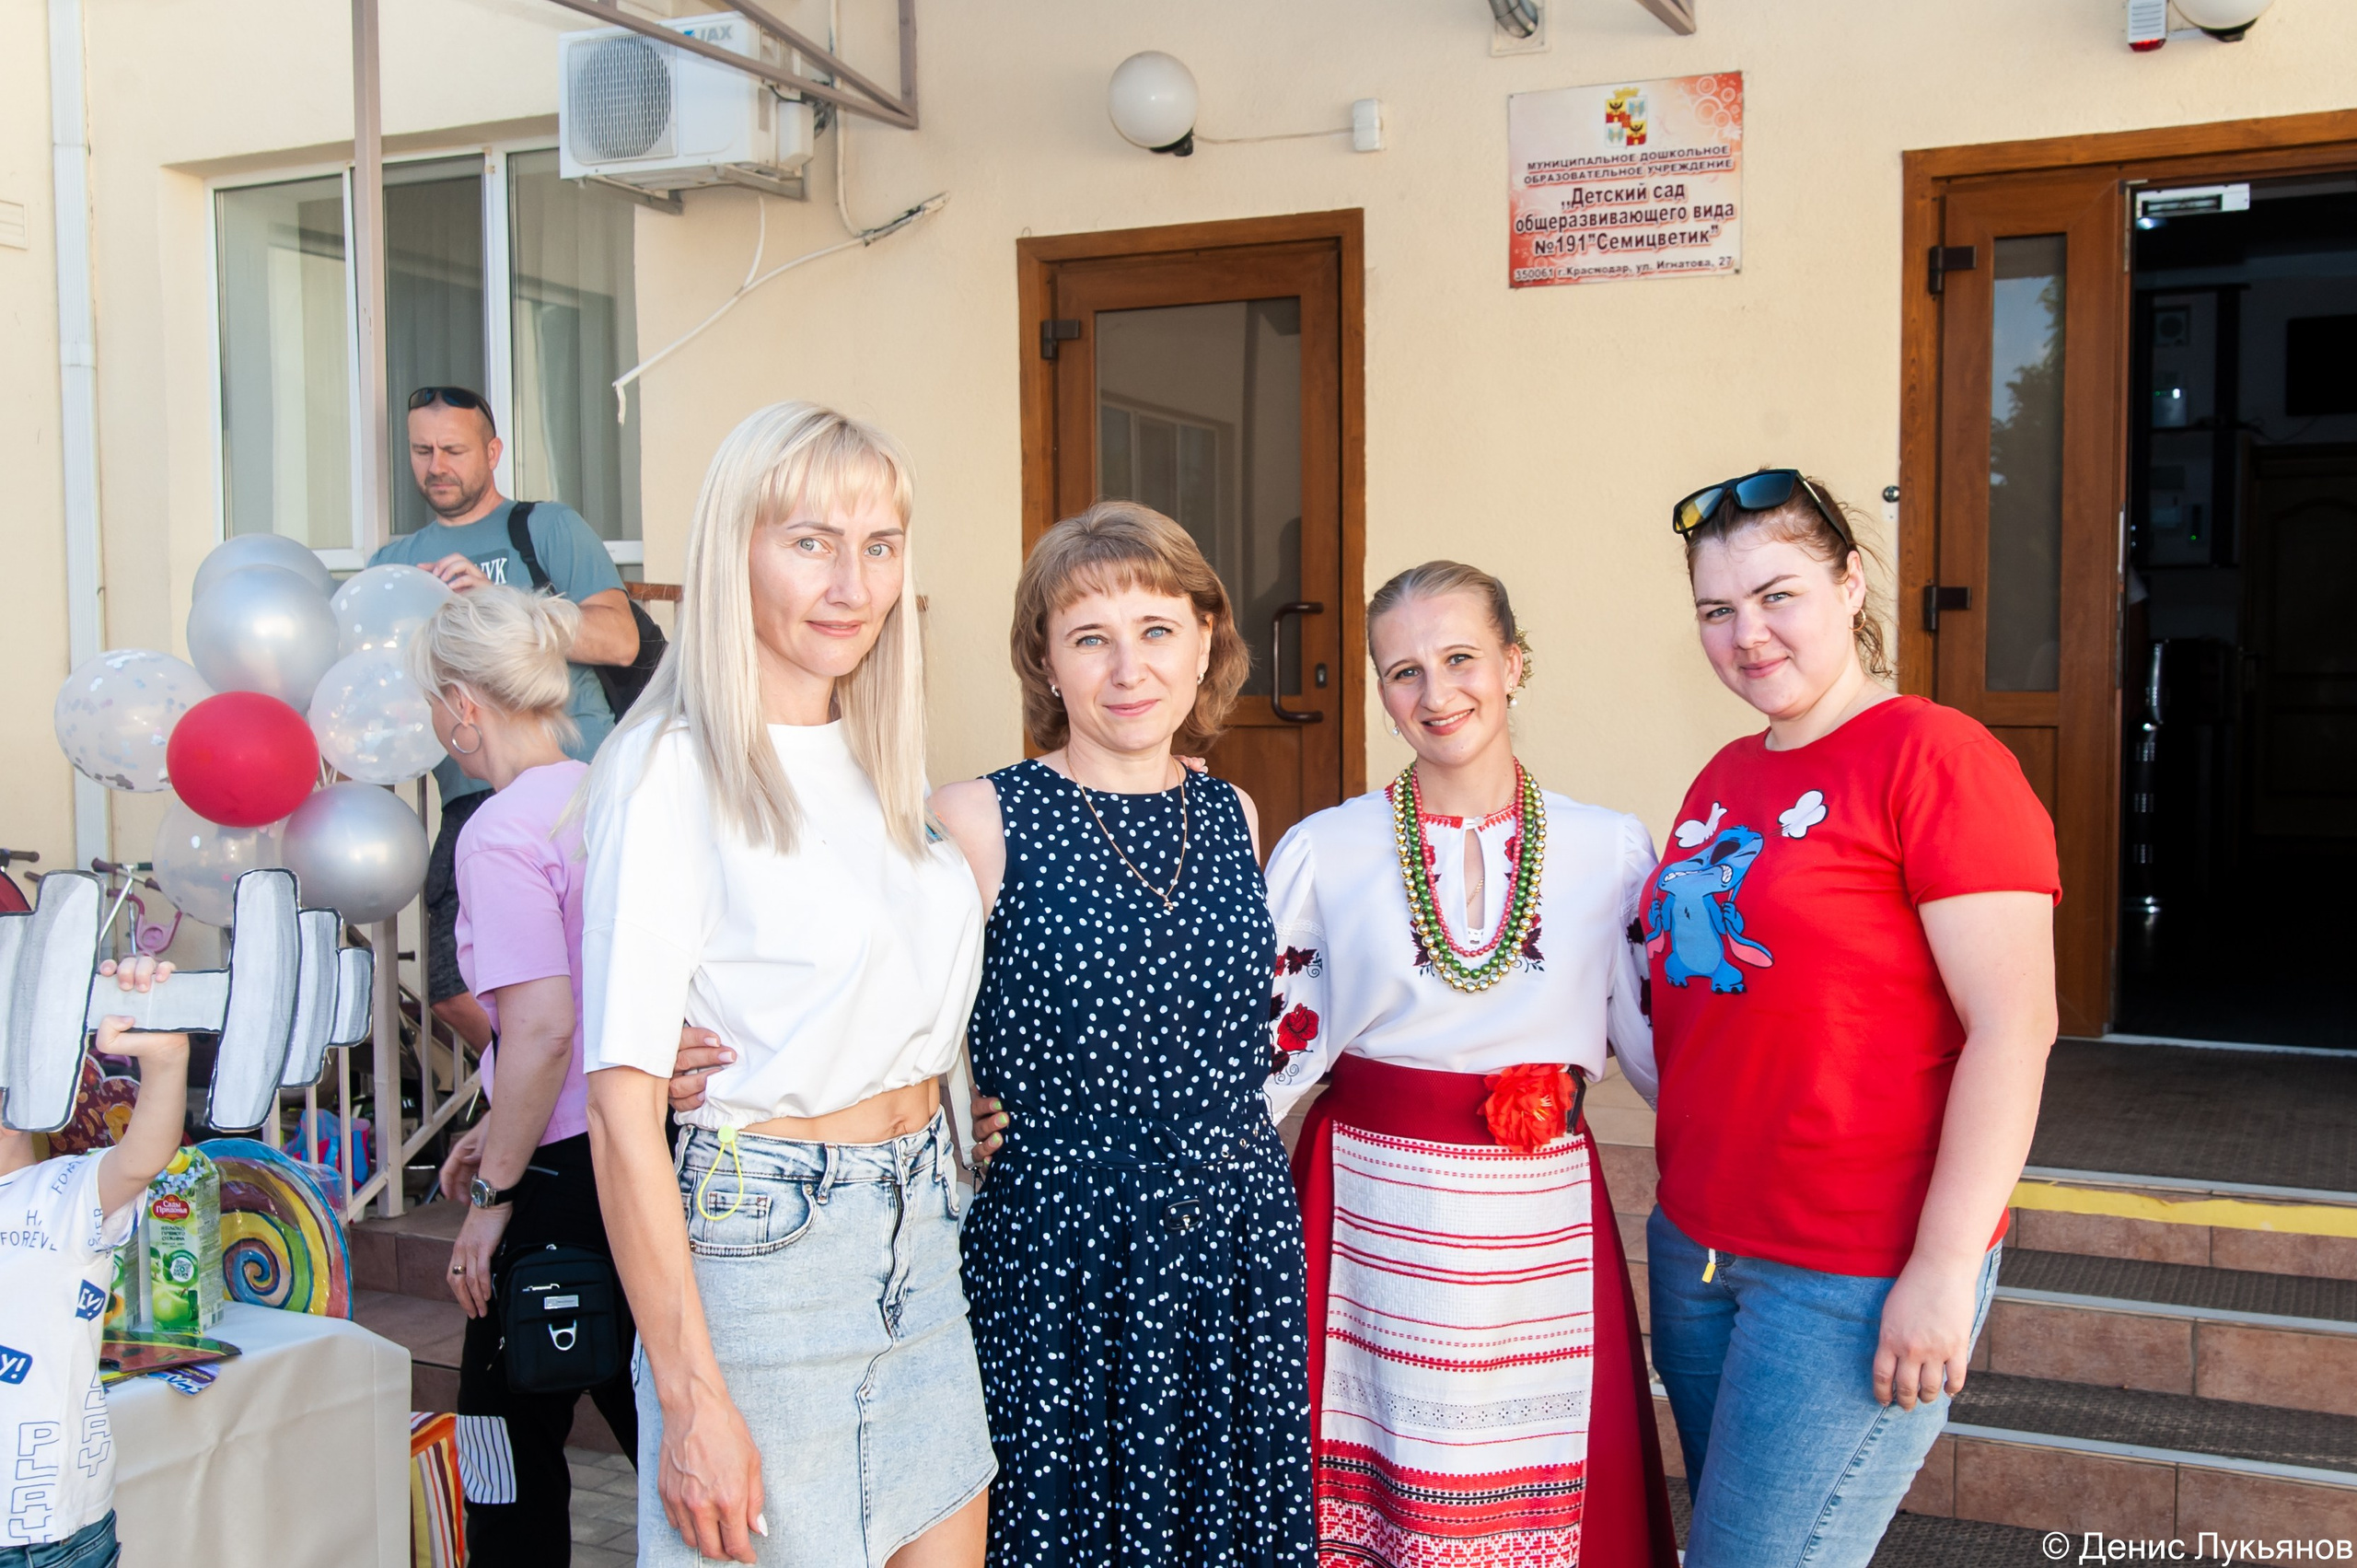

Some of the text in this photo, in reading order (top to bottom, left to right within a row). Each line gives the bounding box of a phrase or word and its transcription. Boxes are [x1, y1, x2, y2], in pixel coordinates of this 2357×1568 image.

[1527, 145, 1729, 170] МУНИЦИПАЛЬНОЕ ДОШКОЛЬНОЕ
[1524, 159, 1733, 185] ОБРАЗОВАТЕЛЬНОЕ УЧРЕЖДЕНИЕ
[1653, 183, 1685, 200] сад
[1515, 203, 1735, 233] общеразвивающего вида
[1635, 263, 1653, 273] ул.
[1656, 260, 1714, 270] Игнатова,
